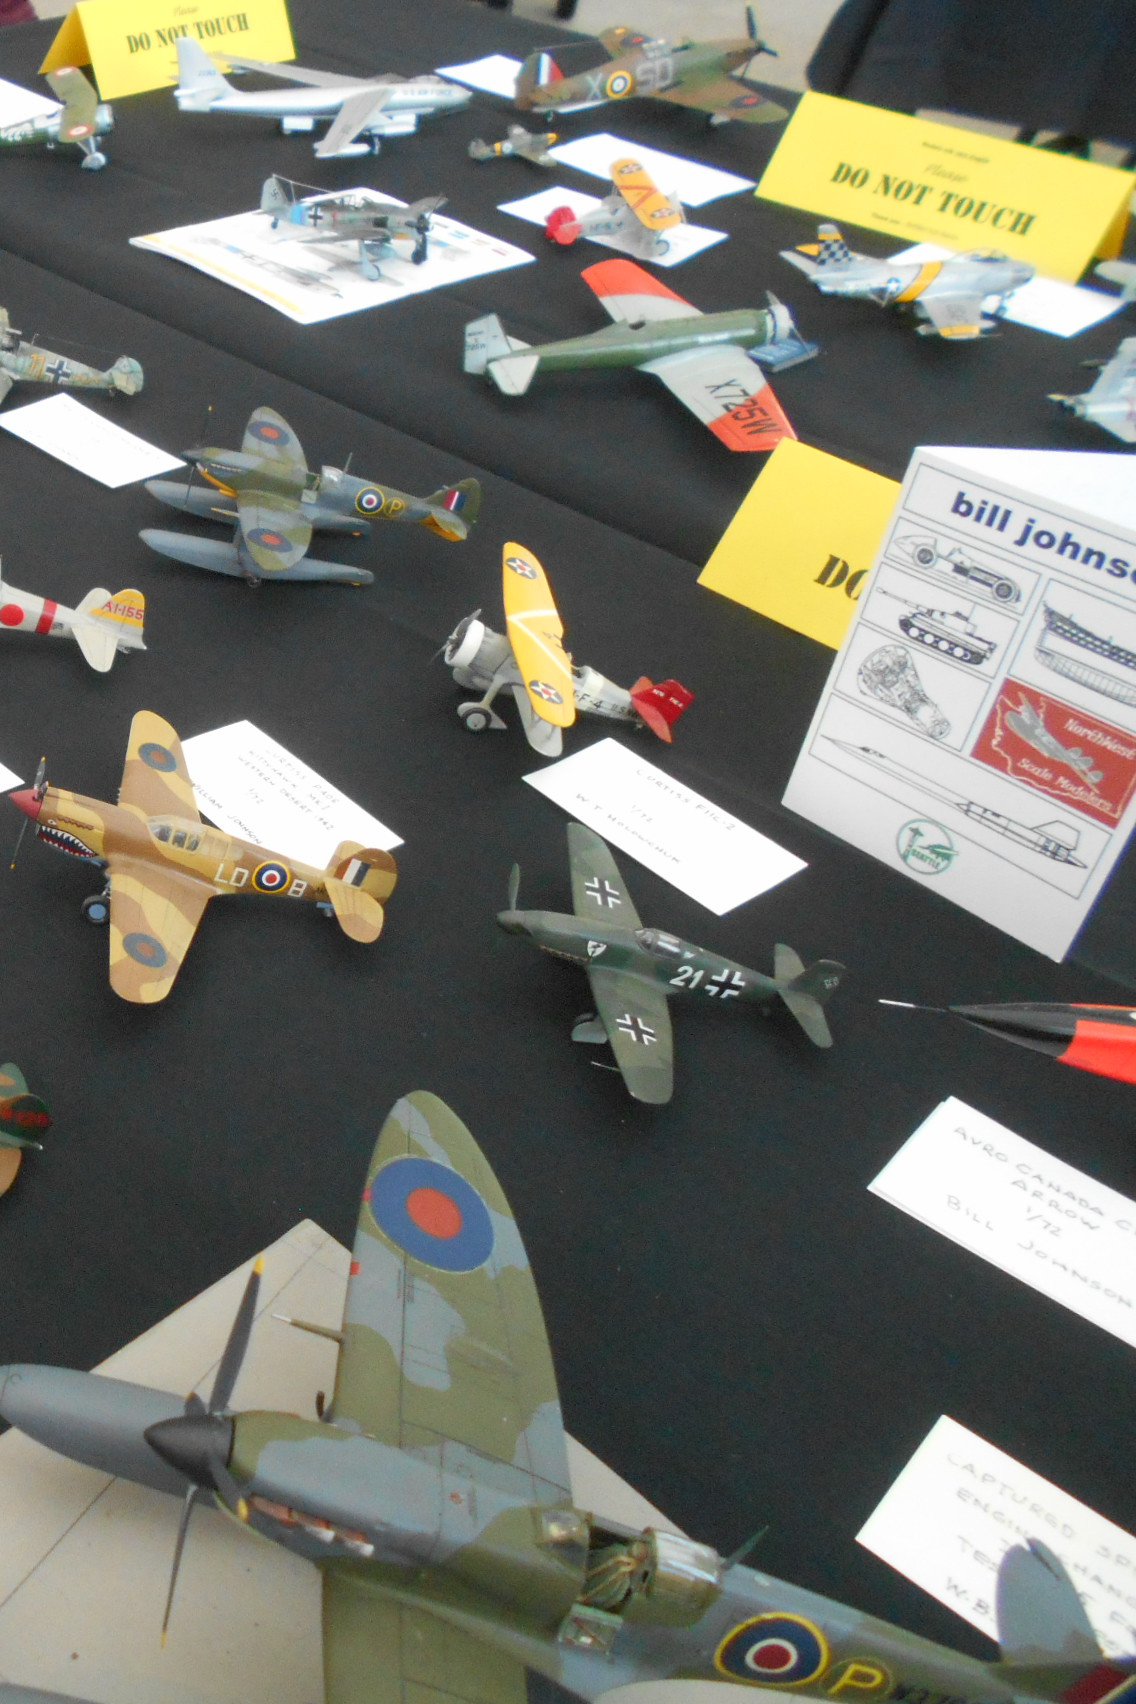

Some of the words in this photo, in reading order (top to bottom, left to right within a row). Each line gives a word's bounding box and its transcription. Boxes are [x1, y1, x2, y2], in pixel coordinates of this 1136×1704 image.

[126, 34, 151, 53] DO
[193, 12, 250, 39] TOUCH
[585, 73, 602, 99] X
[830, 161, 870, 190] DO
[873, 174, 934, 206] NOT
[938, 191, 1037, 237] TOUCH
[704, 378, 783, 436] X725W
[951, 491, 1013, 532] bill
[1014, 518, 1136, 582] johns
[1017, 758, 1052, 781] Scale
[1056, 775, 1114, 812] Modelers
[214, 863, 250, 888] LD
[287, 878, 308, 898] B
[669, 965, 705, 989] 21
[953, 1126, 1009, 1163] AVRO
[1015, 1162, 1105, 1217] CANADA
[1010, 1179, 1101, 1231] ARROW
[1025, 1205, 1062, 1238] 1/72
[946, 1194, 994, 1232] BILL
[1017, 1240, 1134, 1309] JOHNSON
[946, 1453, 1080, 1543] CAPTURED
[826, 1662, 884, 1697] P
